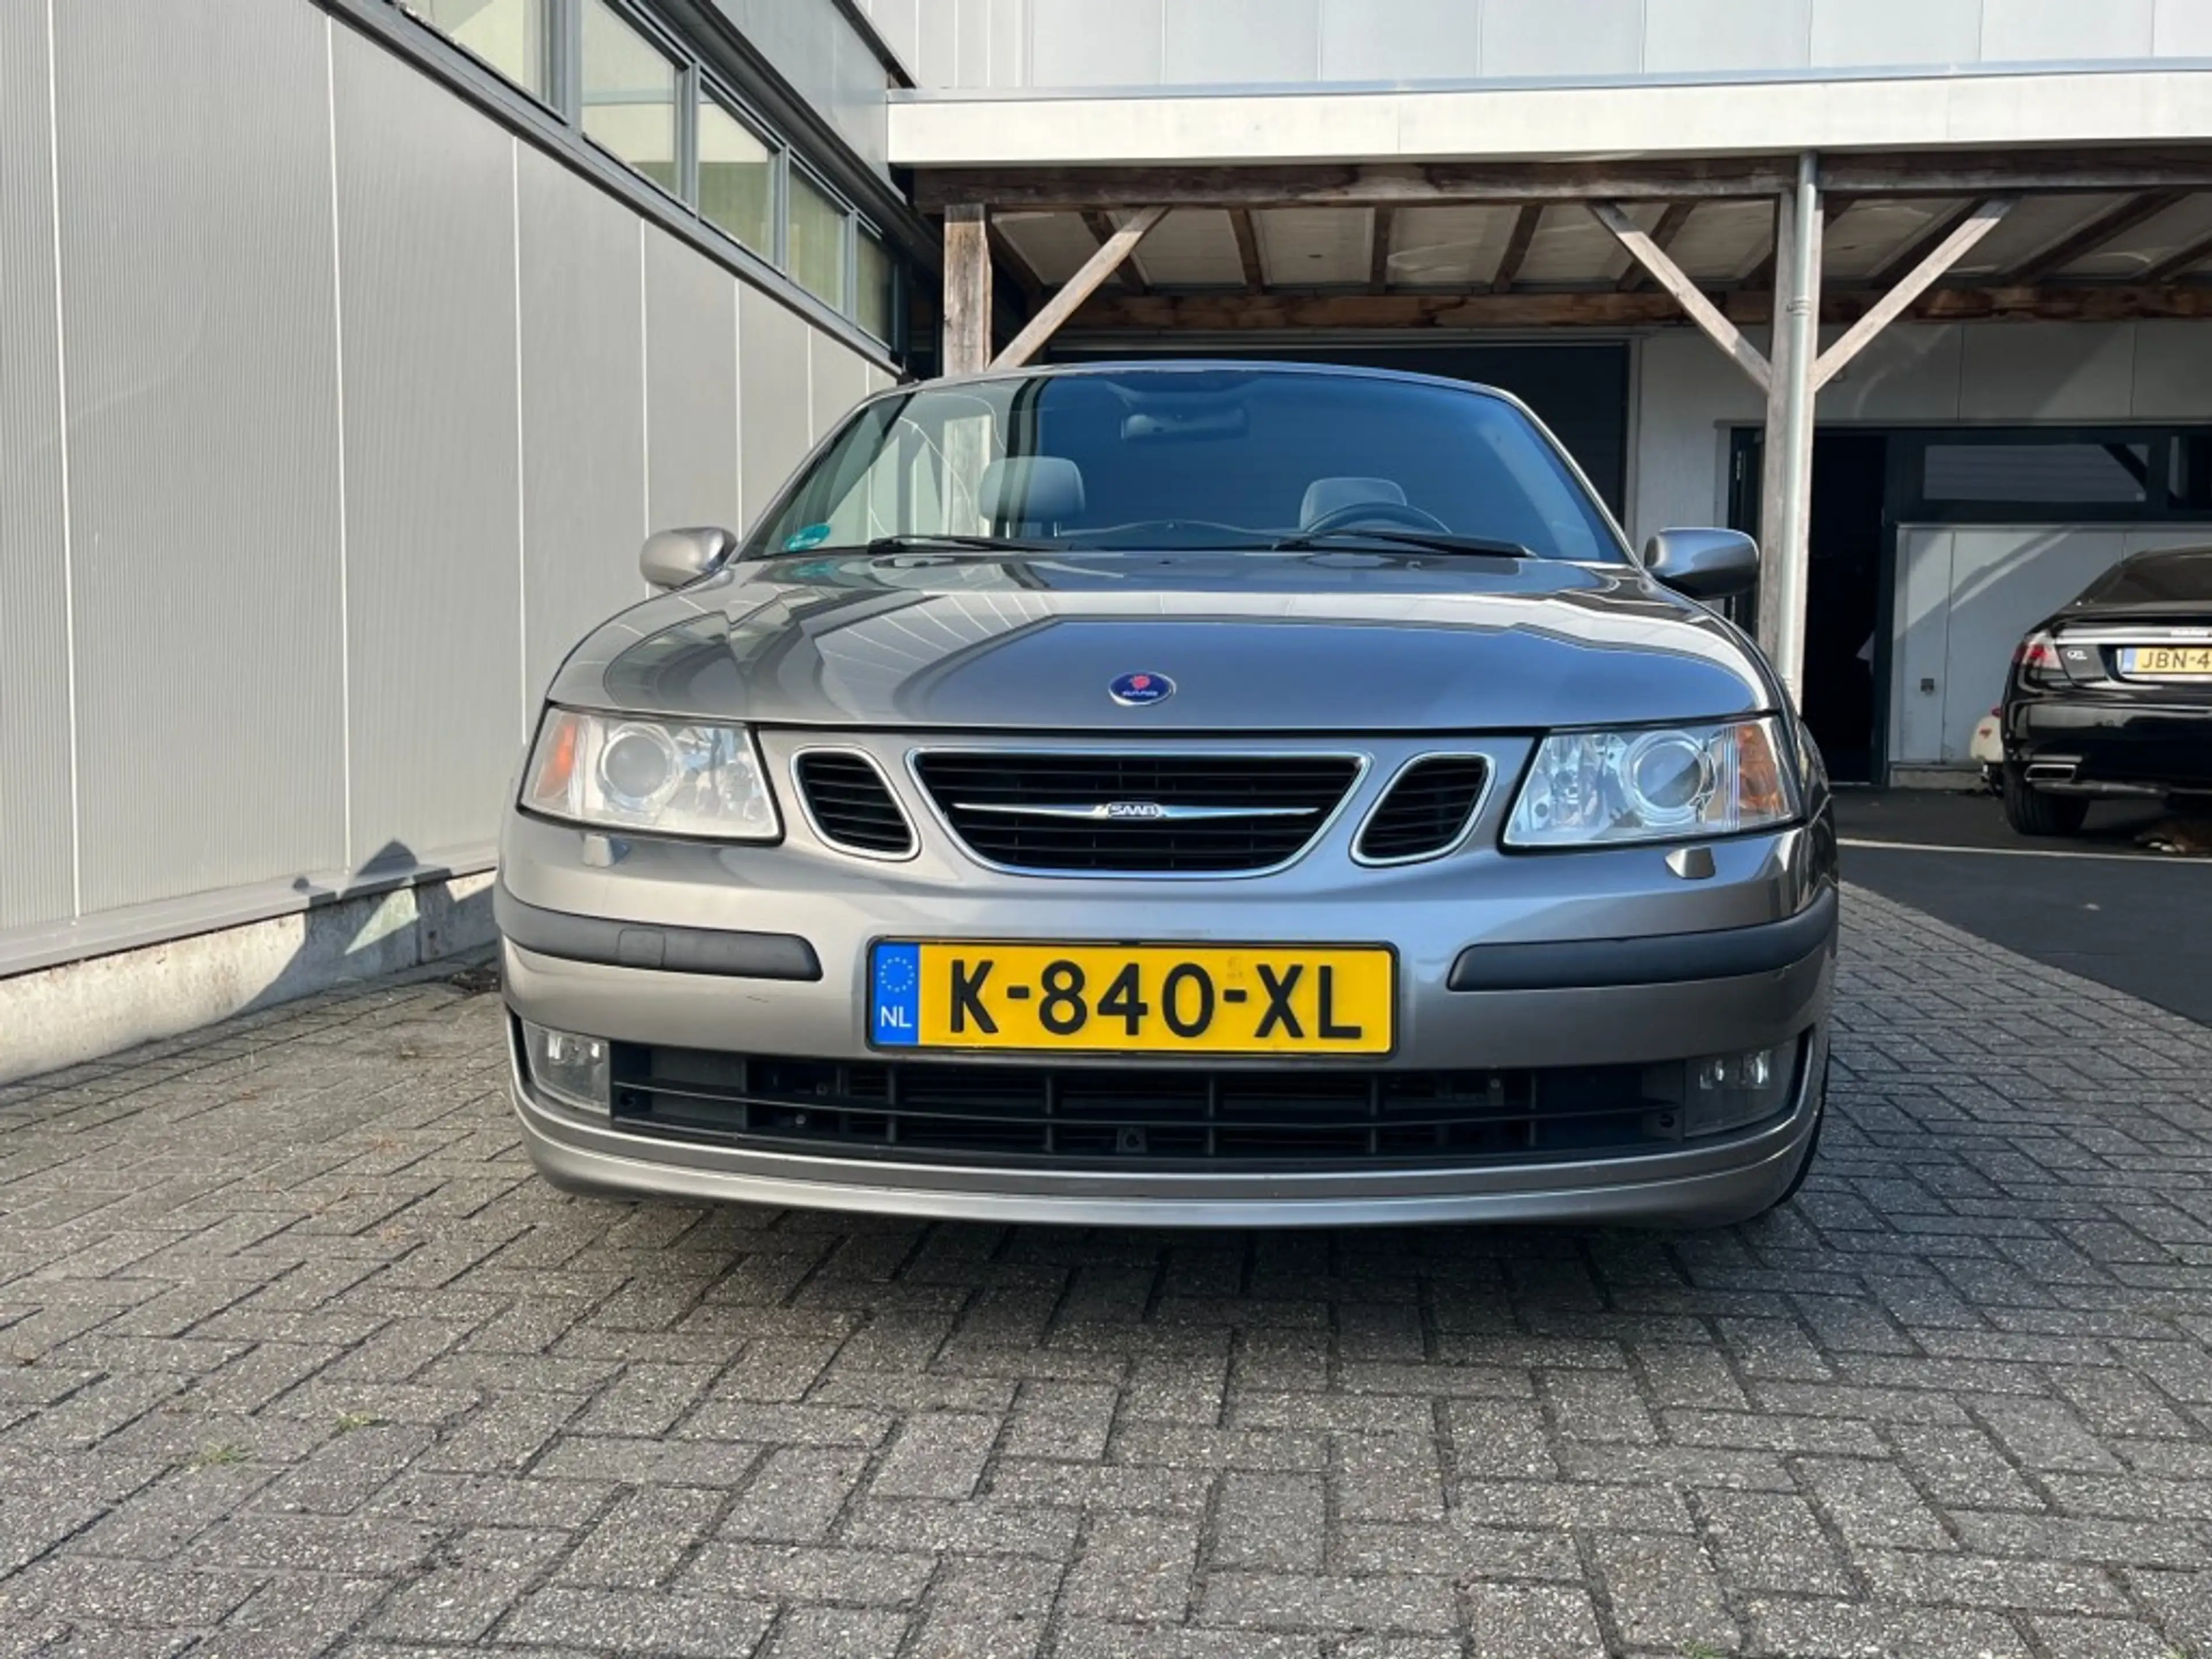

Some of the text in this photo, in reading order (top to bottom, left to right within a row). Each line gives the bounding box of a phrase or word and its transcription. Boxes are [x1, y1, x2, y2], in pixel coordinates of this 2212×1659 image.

[2141, 651, 2210, 669] JBN-4
[1111, 805, 1155, 816] SAAB
[949, 959, 1363, 1040] K-840-XL
[881, 1005, 912, 1027] NL
